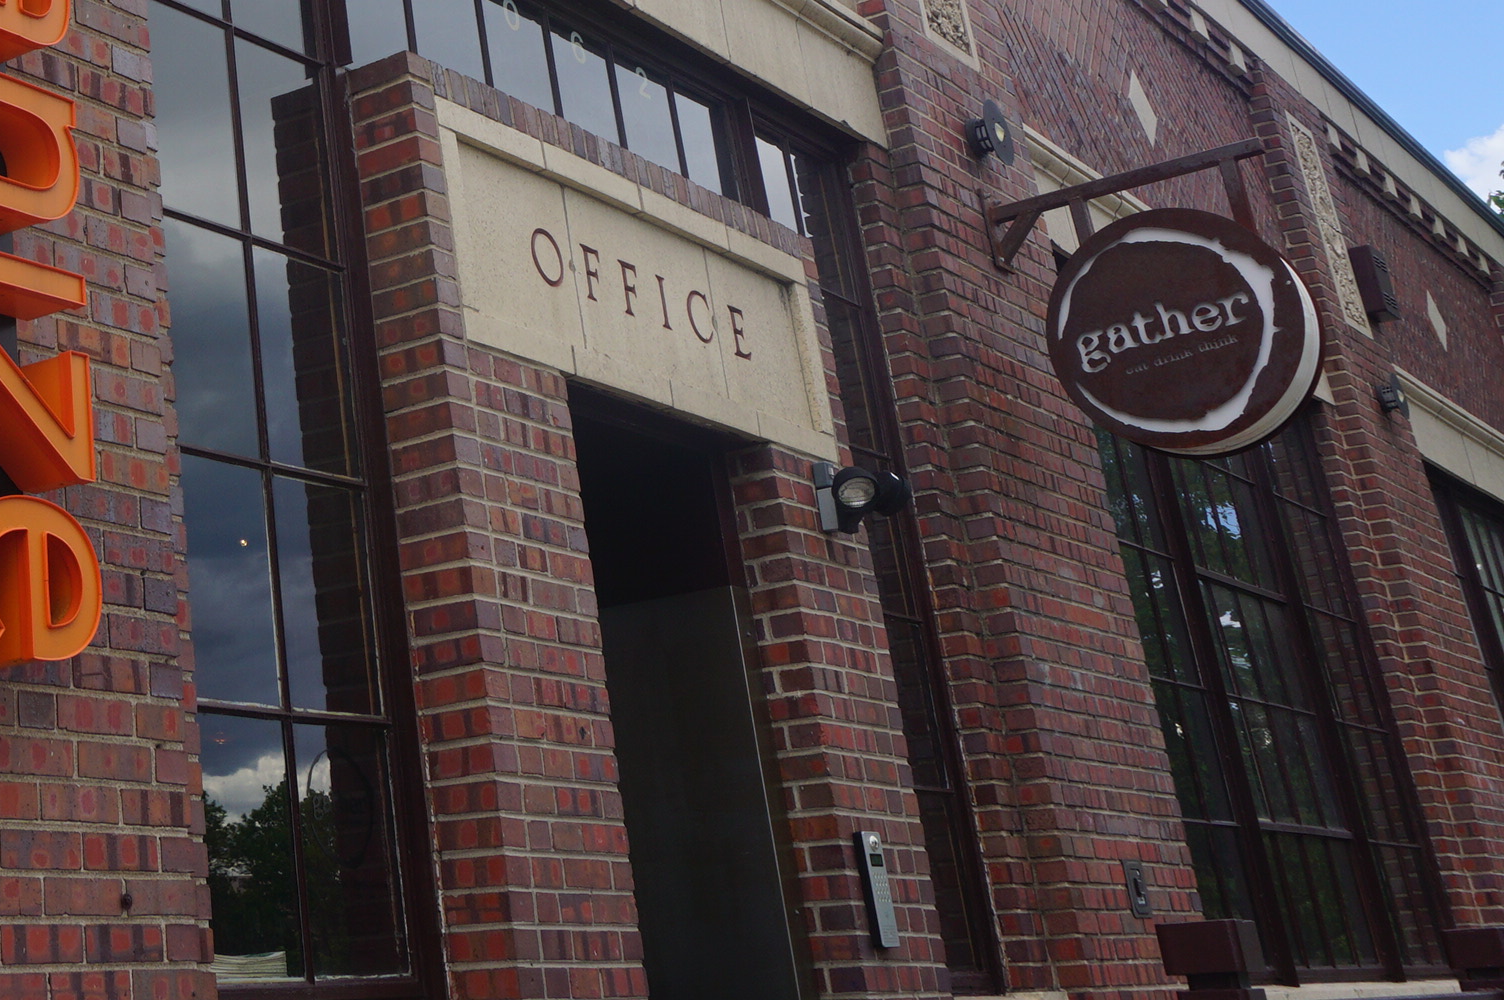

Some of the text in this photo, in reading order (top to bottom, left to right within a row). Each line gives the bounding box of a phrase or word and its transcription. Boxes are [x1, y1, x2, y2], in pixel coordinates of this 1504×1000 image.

[530, 227, 752, 361] OFFICE
[1076, 291, 1249, 374] gather
[1198, 333, 1240, 353] think
